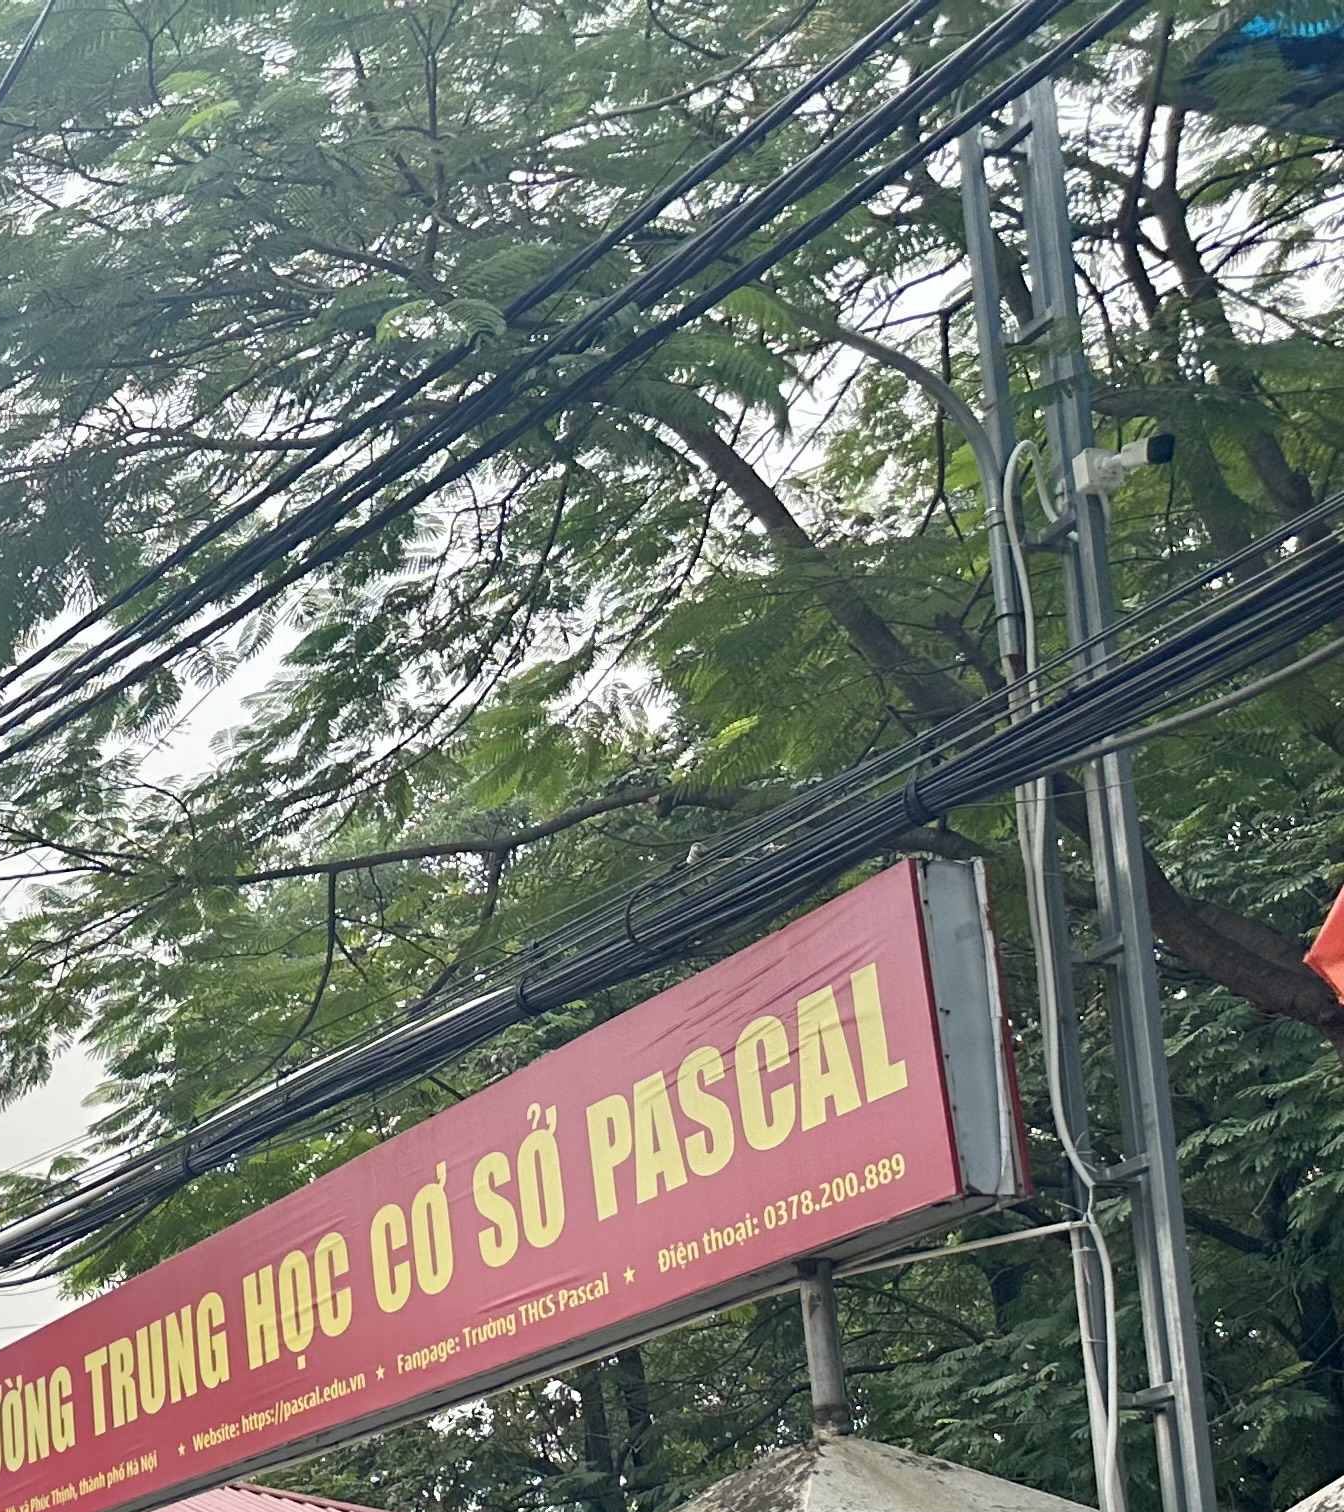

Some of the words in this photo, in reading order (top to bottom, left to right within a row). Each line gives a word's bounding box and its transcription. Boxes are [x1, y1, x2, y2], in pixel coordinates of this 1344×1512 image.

[84, 1291, 230, 1436] TRUNG
[242, 1231, 352, 1371] HỌC
[370, 1160, 454, 1314] CƠ
[472, 1102, 565, 1268] SỞ
[586, 962, 908, 1222] PASCAL
[657, 1240, 700, 1273] Điện
[702, 1212, 760, 1256] thoại:
[763, 1152, 906, 1230] 0378.200.889
[396, 1336, 460, 1374] Fanpage:
[462, 1312, 516, 1348] Trường
[518, 1296, 556, 1326] THCS
[558, 1271, 609, 1311] Pascal
[192, 1423, 240, 1452] Website:
[241, 1372, 366, 1434] https://pascal.edu.vn
[79, 1471, 106, 1496] thành
[107, 1462, 124, 1488] phố
[126, 1459, 139, 1478] Hà
[141, 1450, 158, 1473] Nội
